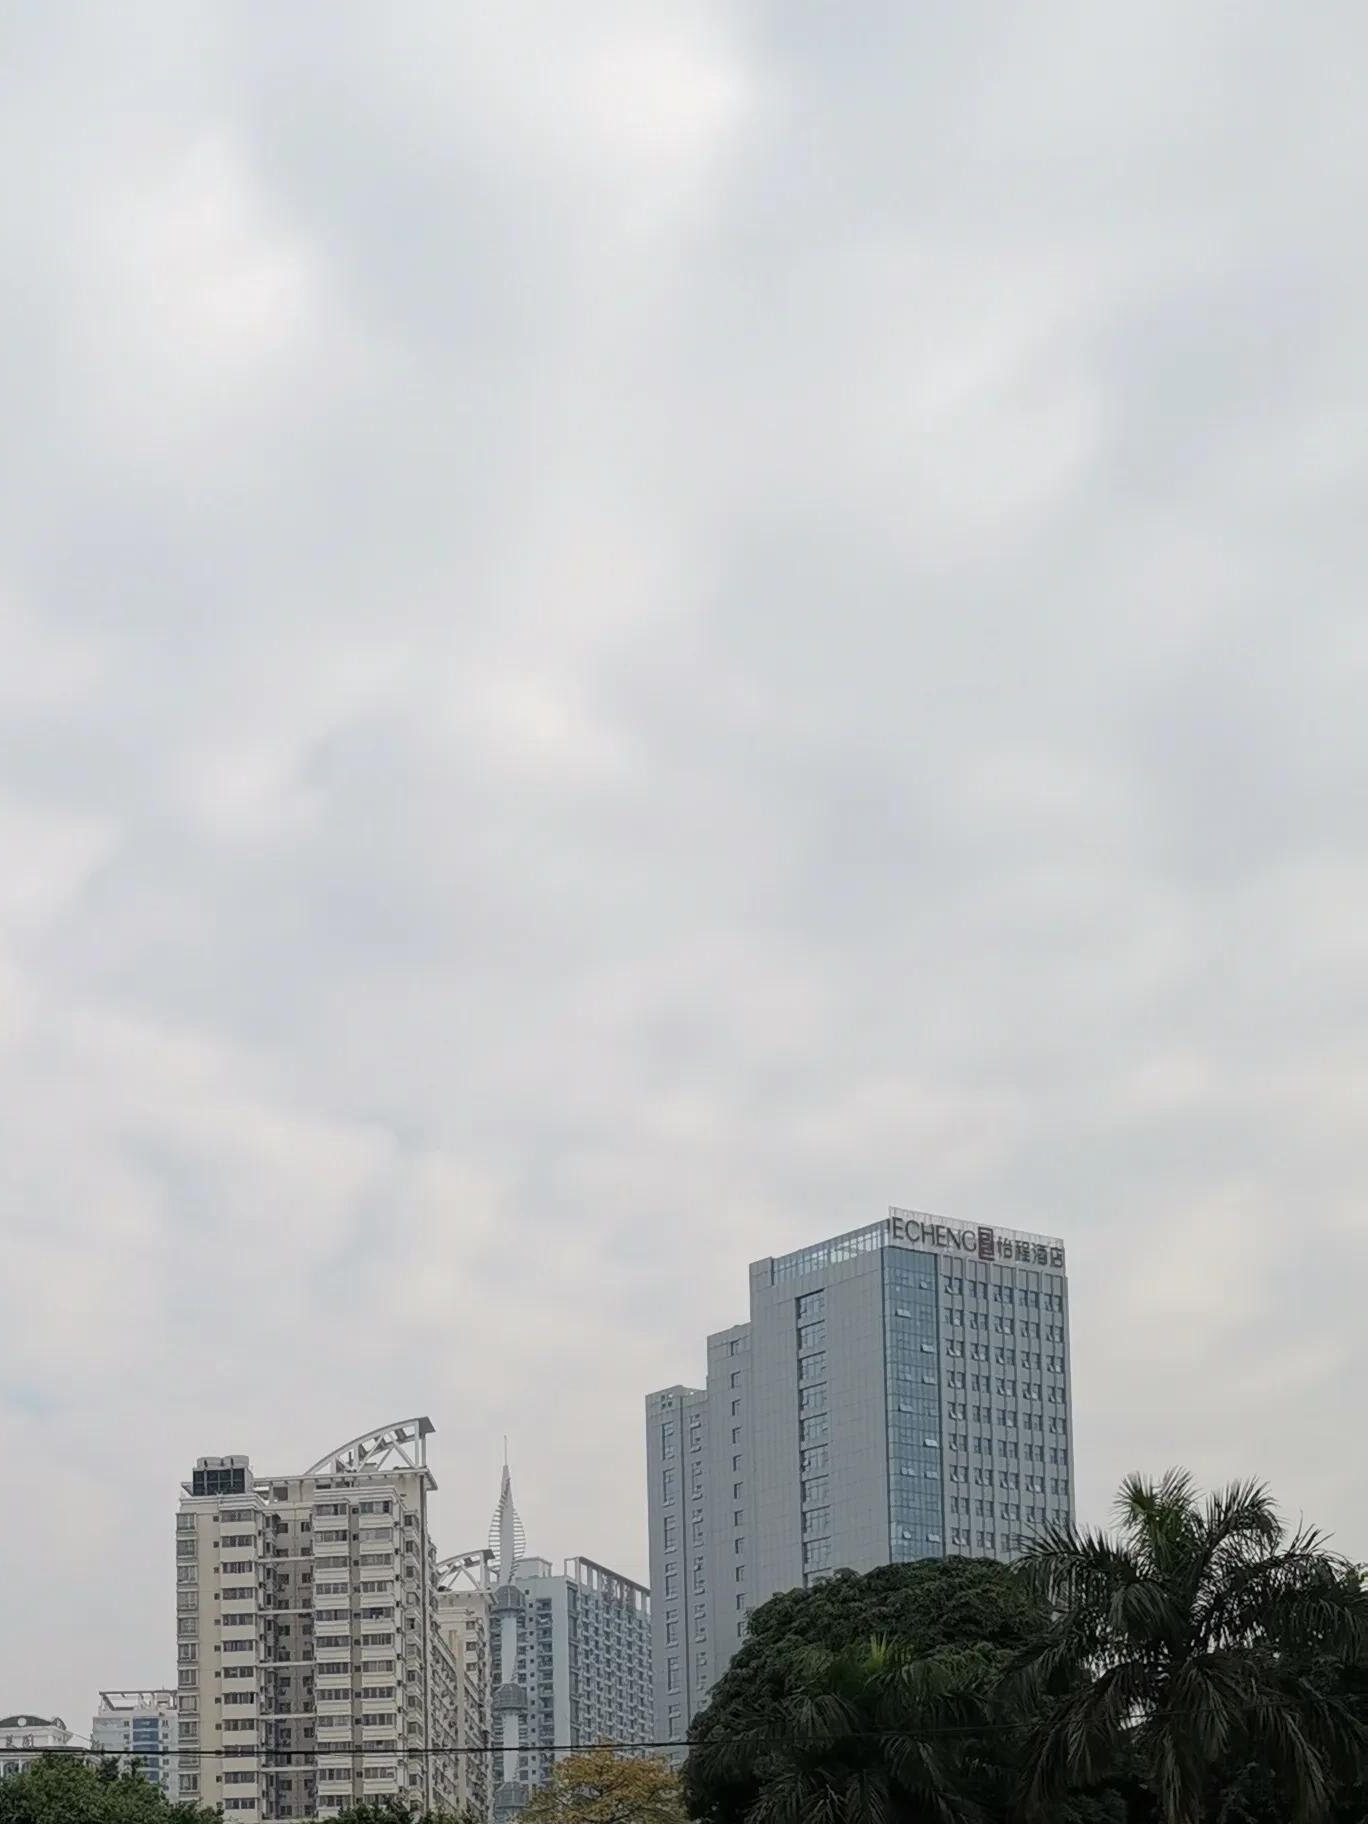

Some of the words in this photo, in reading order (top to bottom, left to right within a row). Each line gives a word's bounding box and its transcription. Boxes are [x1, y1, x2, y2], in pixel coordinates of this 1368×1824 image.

[892, 1217, 978, 1252] ECHENG
[997, 1236, 1065, 1268] 怡程酒店
